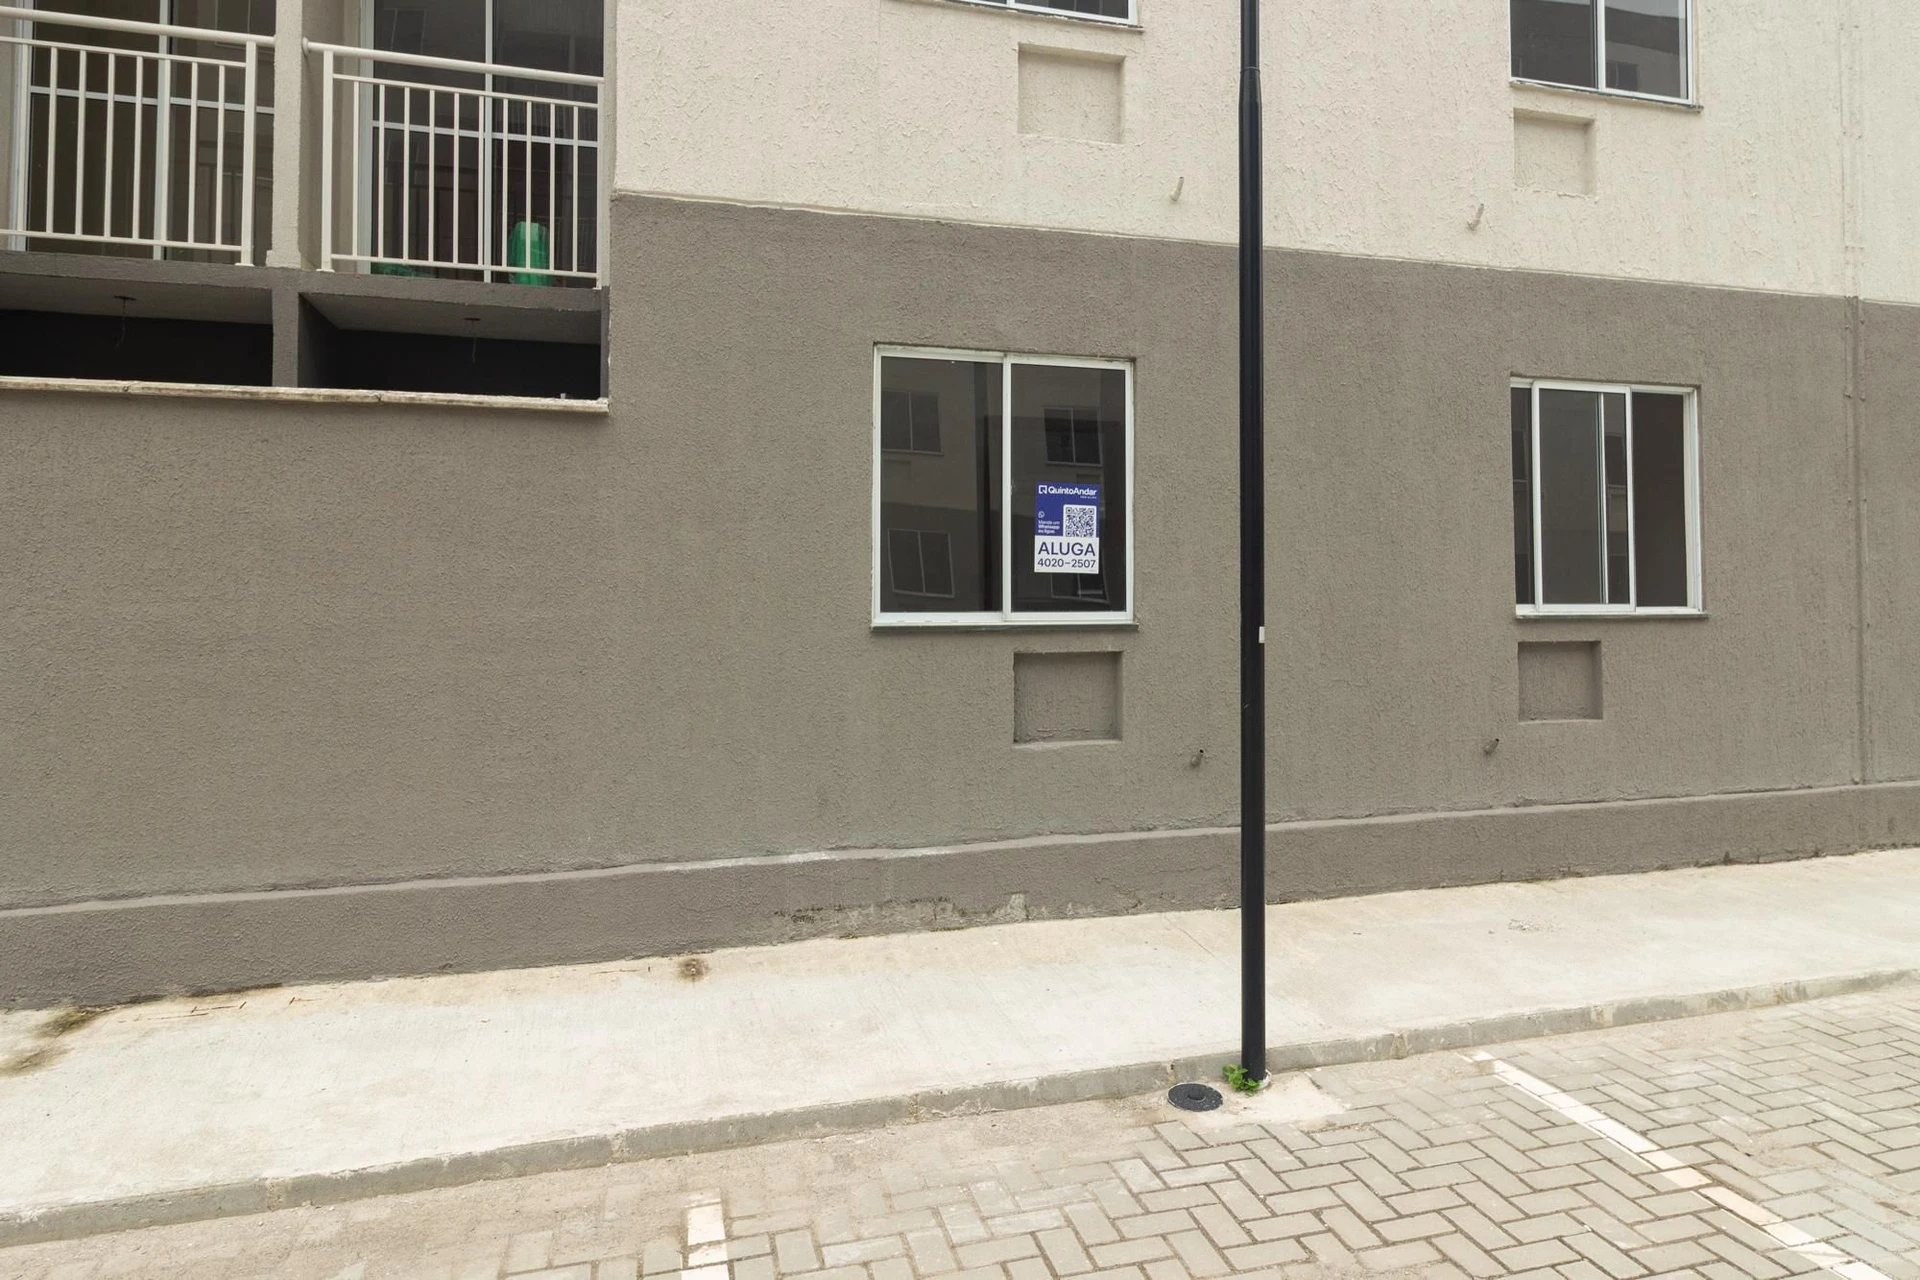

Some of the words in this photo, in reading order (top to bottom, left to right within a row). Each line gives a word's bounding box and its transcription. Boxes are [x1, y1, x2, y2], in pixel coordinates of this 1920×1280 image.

[1048, 486, 1097, 496] QuintoAndar
[1038, 541, 1096, 556] ALUGA
[1037, 558, 1097, 568] 4020-2507
